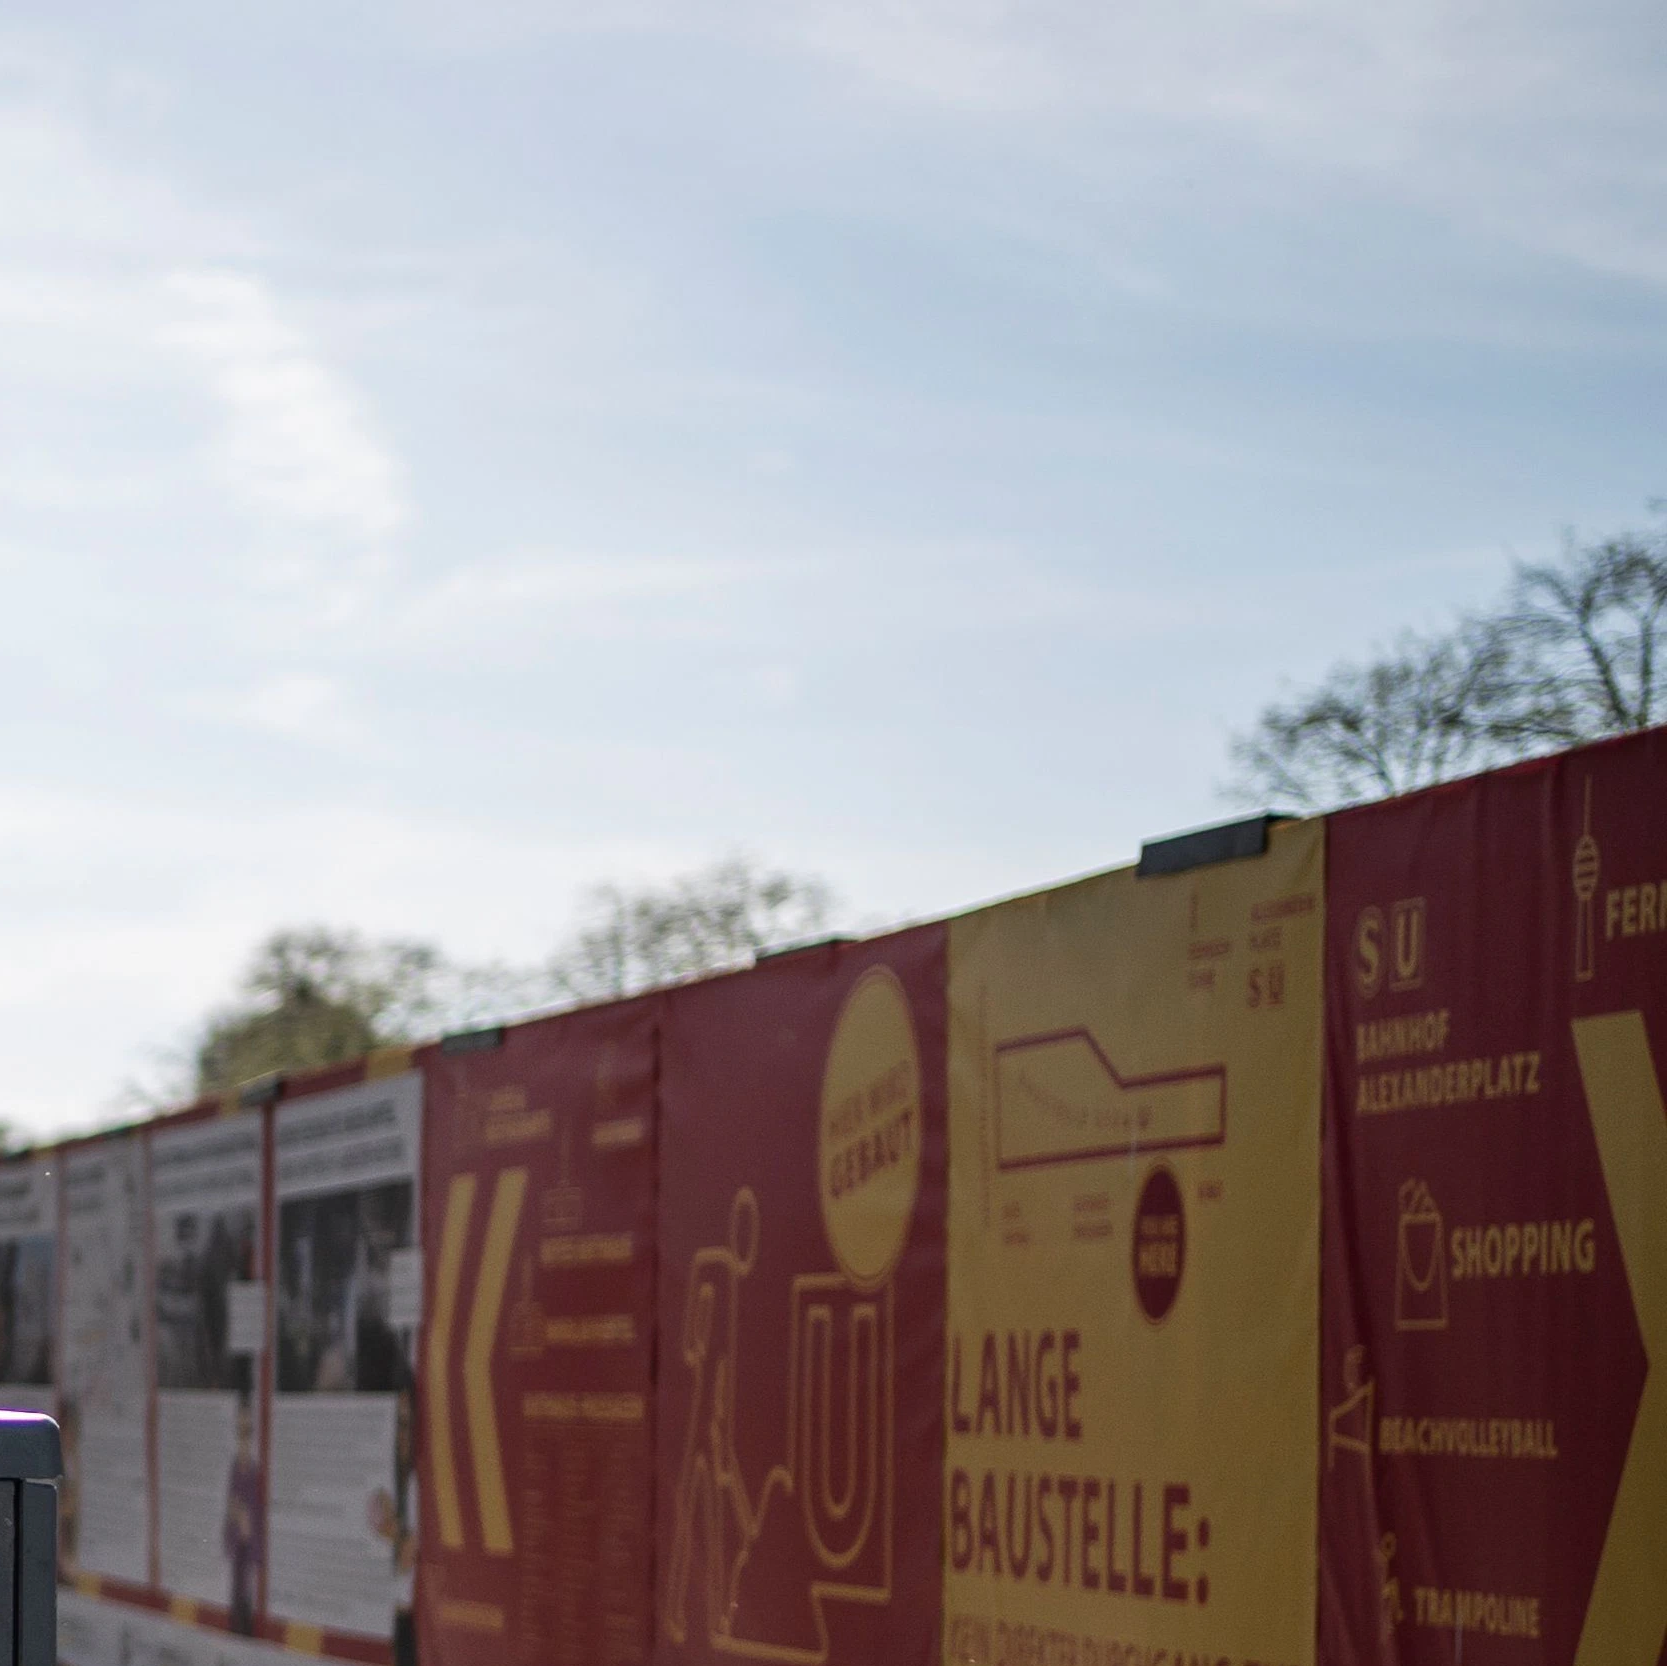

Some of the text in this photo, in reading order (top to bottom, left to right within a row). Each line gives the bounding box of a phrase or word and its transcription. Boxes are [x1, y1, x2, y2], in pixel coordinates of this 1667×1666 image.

[1355, 1008, 1450, 1064] BAHNHOF
[1355, 1051, 1541, 1116] ALEXANDERPLATZ
[1450, 1218, 1595, 1281] SHOPPING
[951, 1329, 1083, 1441] LANGE
[1379, 1415, 1559, 1460] BEACHVOLLEYBALL
[950, 1466, 1211, 1606] BAUSTELLE:
[1414, 1586, 1541, 1640] TRAMPOLINE
